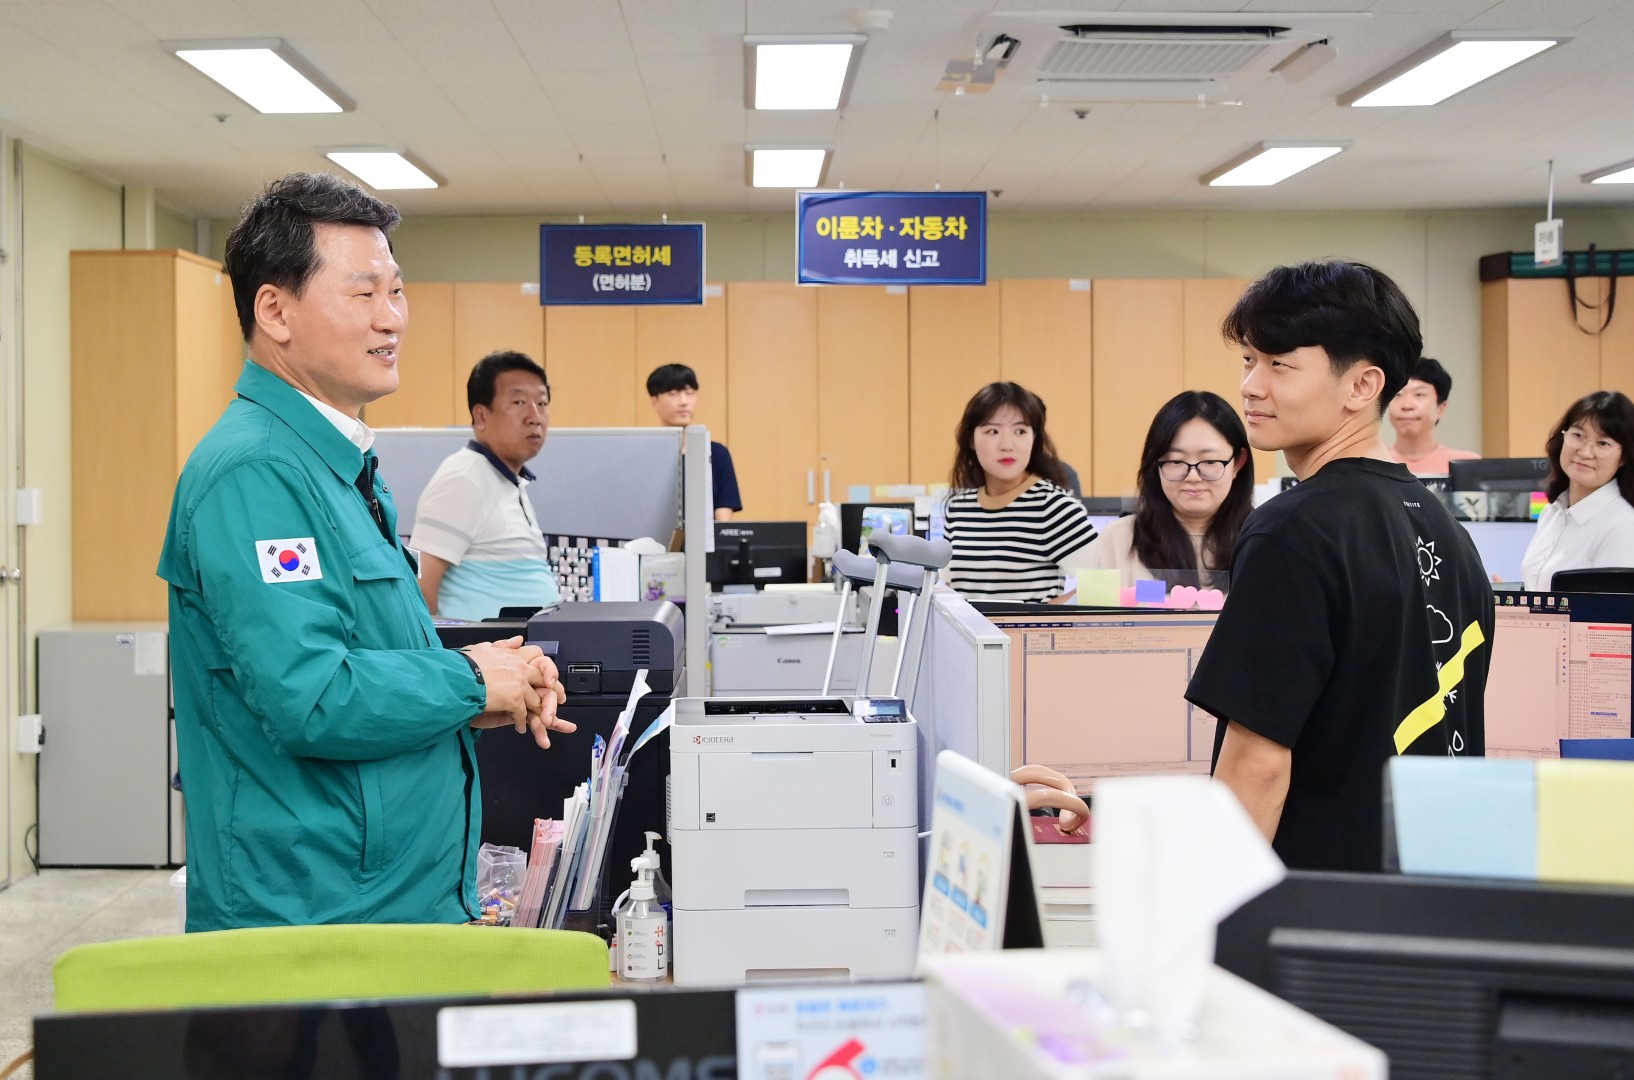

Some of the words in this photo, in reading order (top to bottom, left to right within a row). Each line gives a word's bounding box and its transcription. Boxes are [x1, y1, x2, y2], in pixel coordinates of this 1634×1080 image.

[574, 245, 671, 267] 등록면허세
[844, 249, 897, 268] 취득세
[904, 249, 940, 268] 신고
[592, 273, 652, 292] (면허분)
